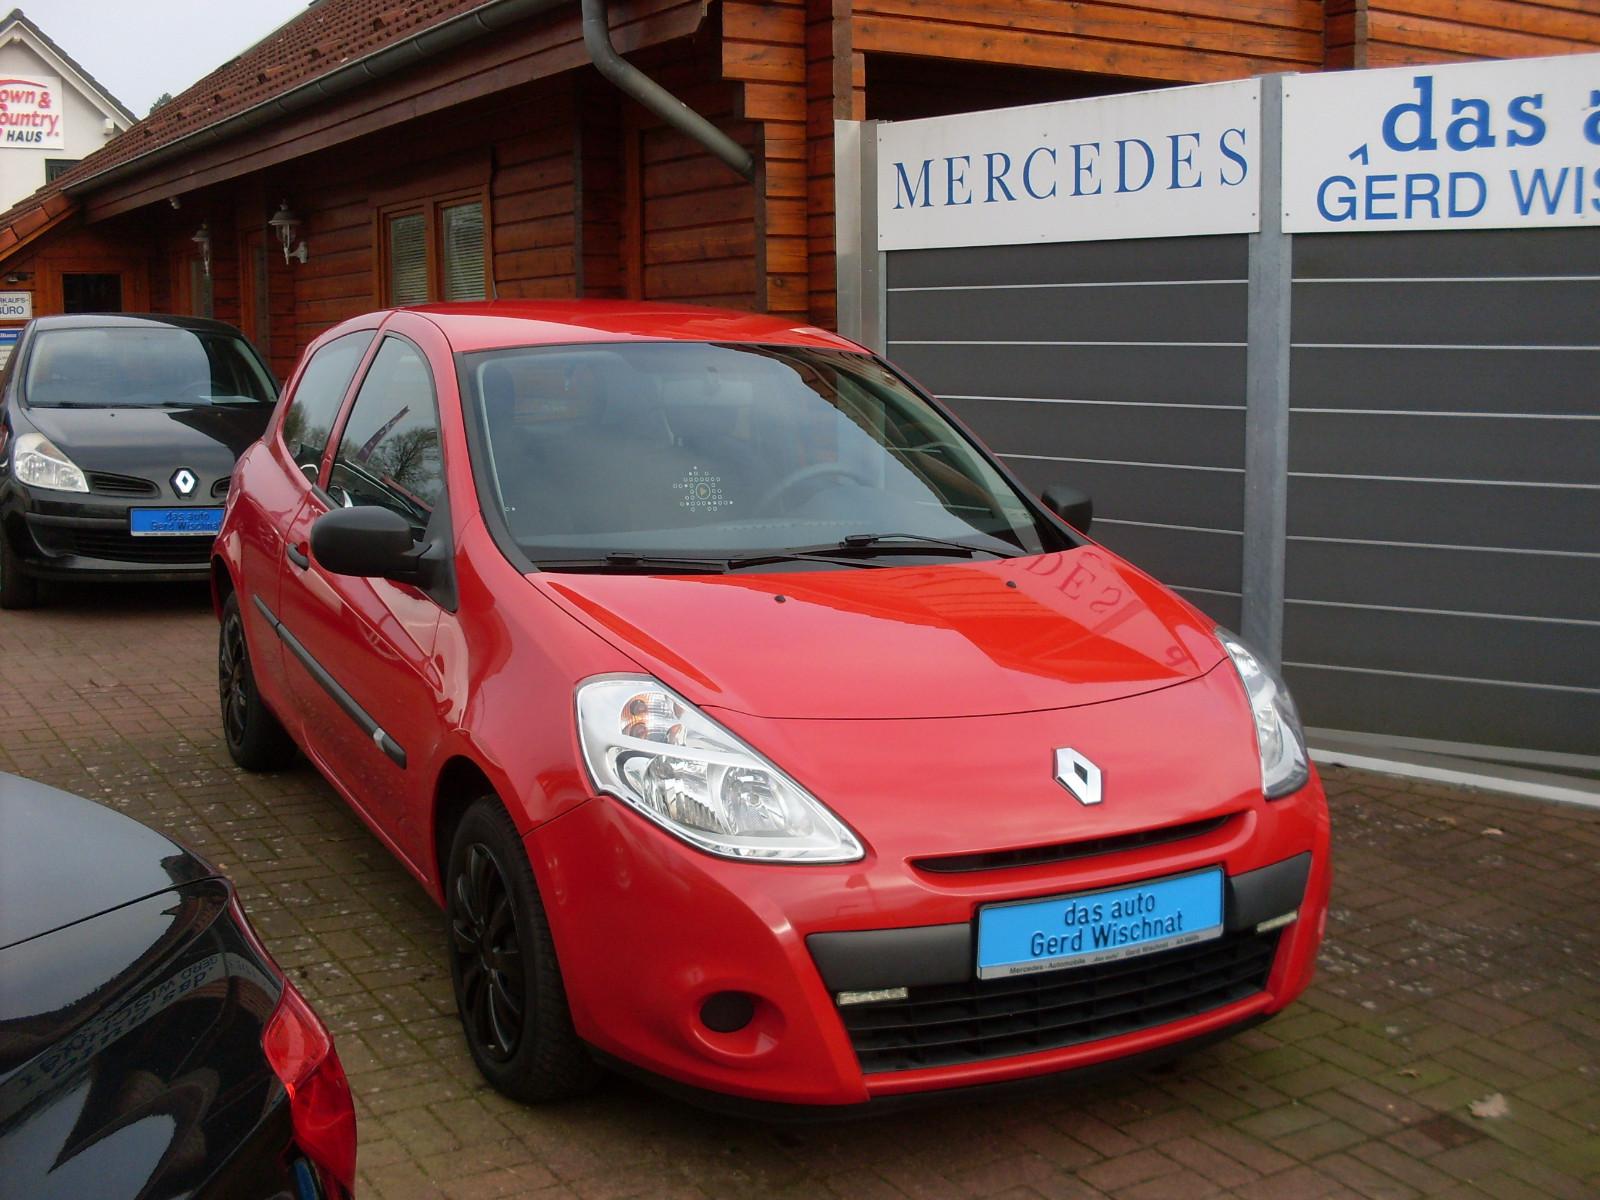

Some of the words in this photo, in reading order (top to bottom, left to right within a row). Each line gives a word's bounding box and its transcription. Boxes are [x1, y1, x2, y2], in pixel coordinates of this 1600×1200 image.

[0, 104, 59, 137] ountry
[38, 91, 51, 109] &
[1382, 75, 1547, 152] das
[7, 130, 43, 143] HAUS
[892, 127, 1248, 210] MERCEDES
[1316, 171, 1487, 223] GERD
[1509, 166, 1600, 216] WI
[1064, 900, 1103, 926] das
[1111, 891, 1155, 918] auto
[1031, 927, 1082, 957] Gerd
[1092, 910, 1184, 949] Wischnat
